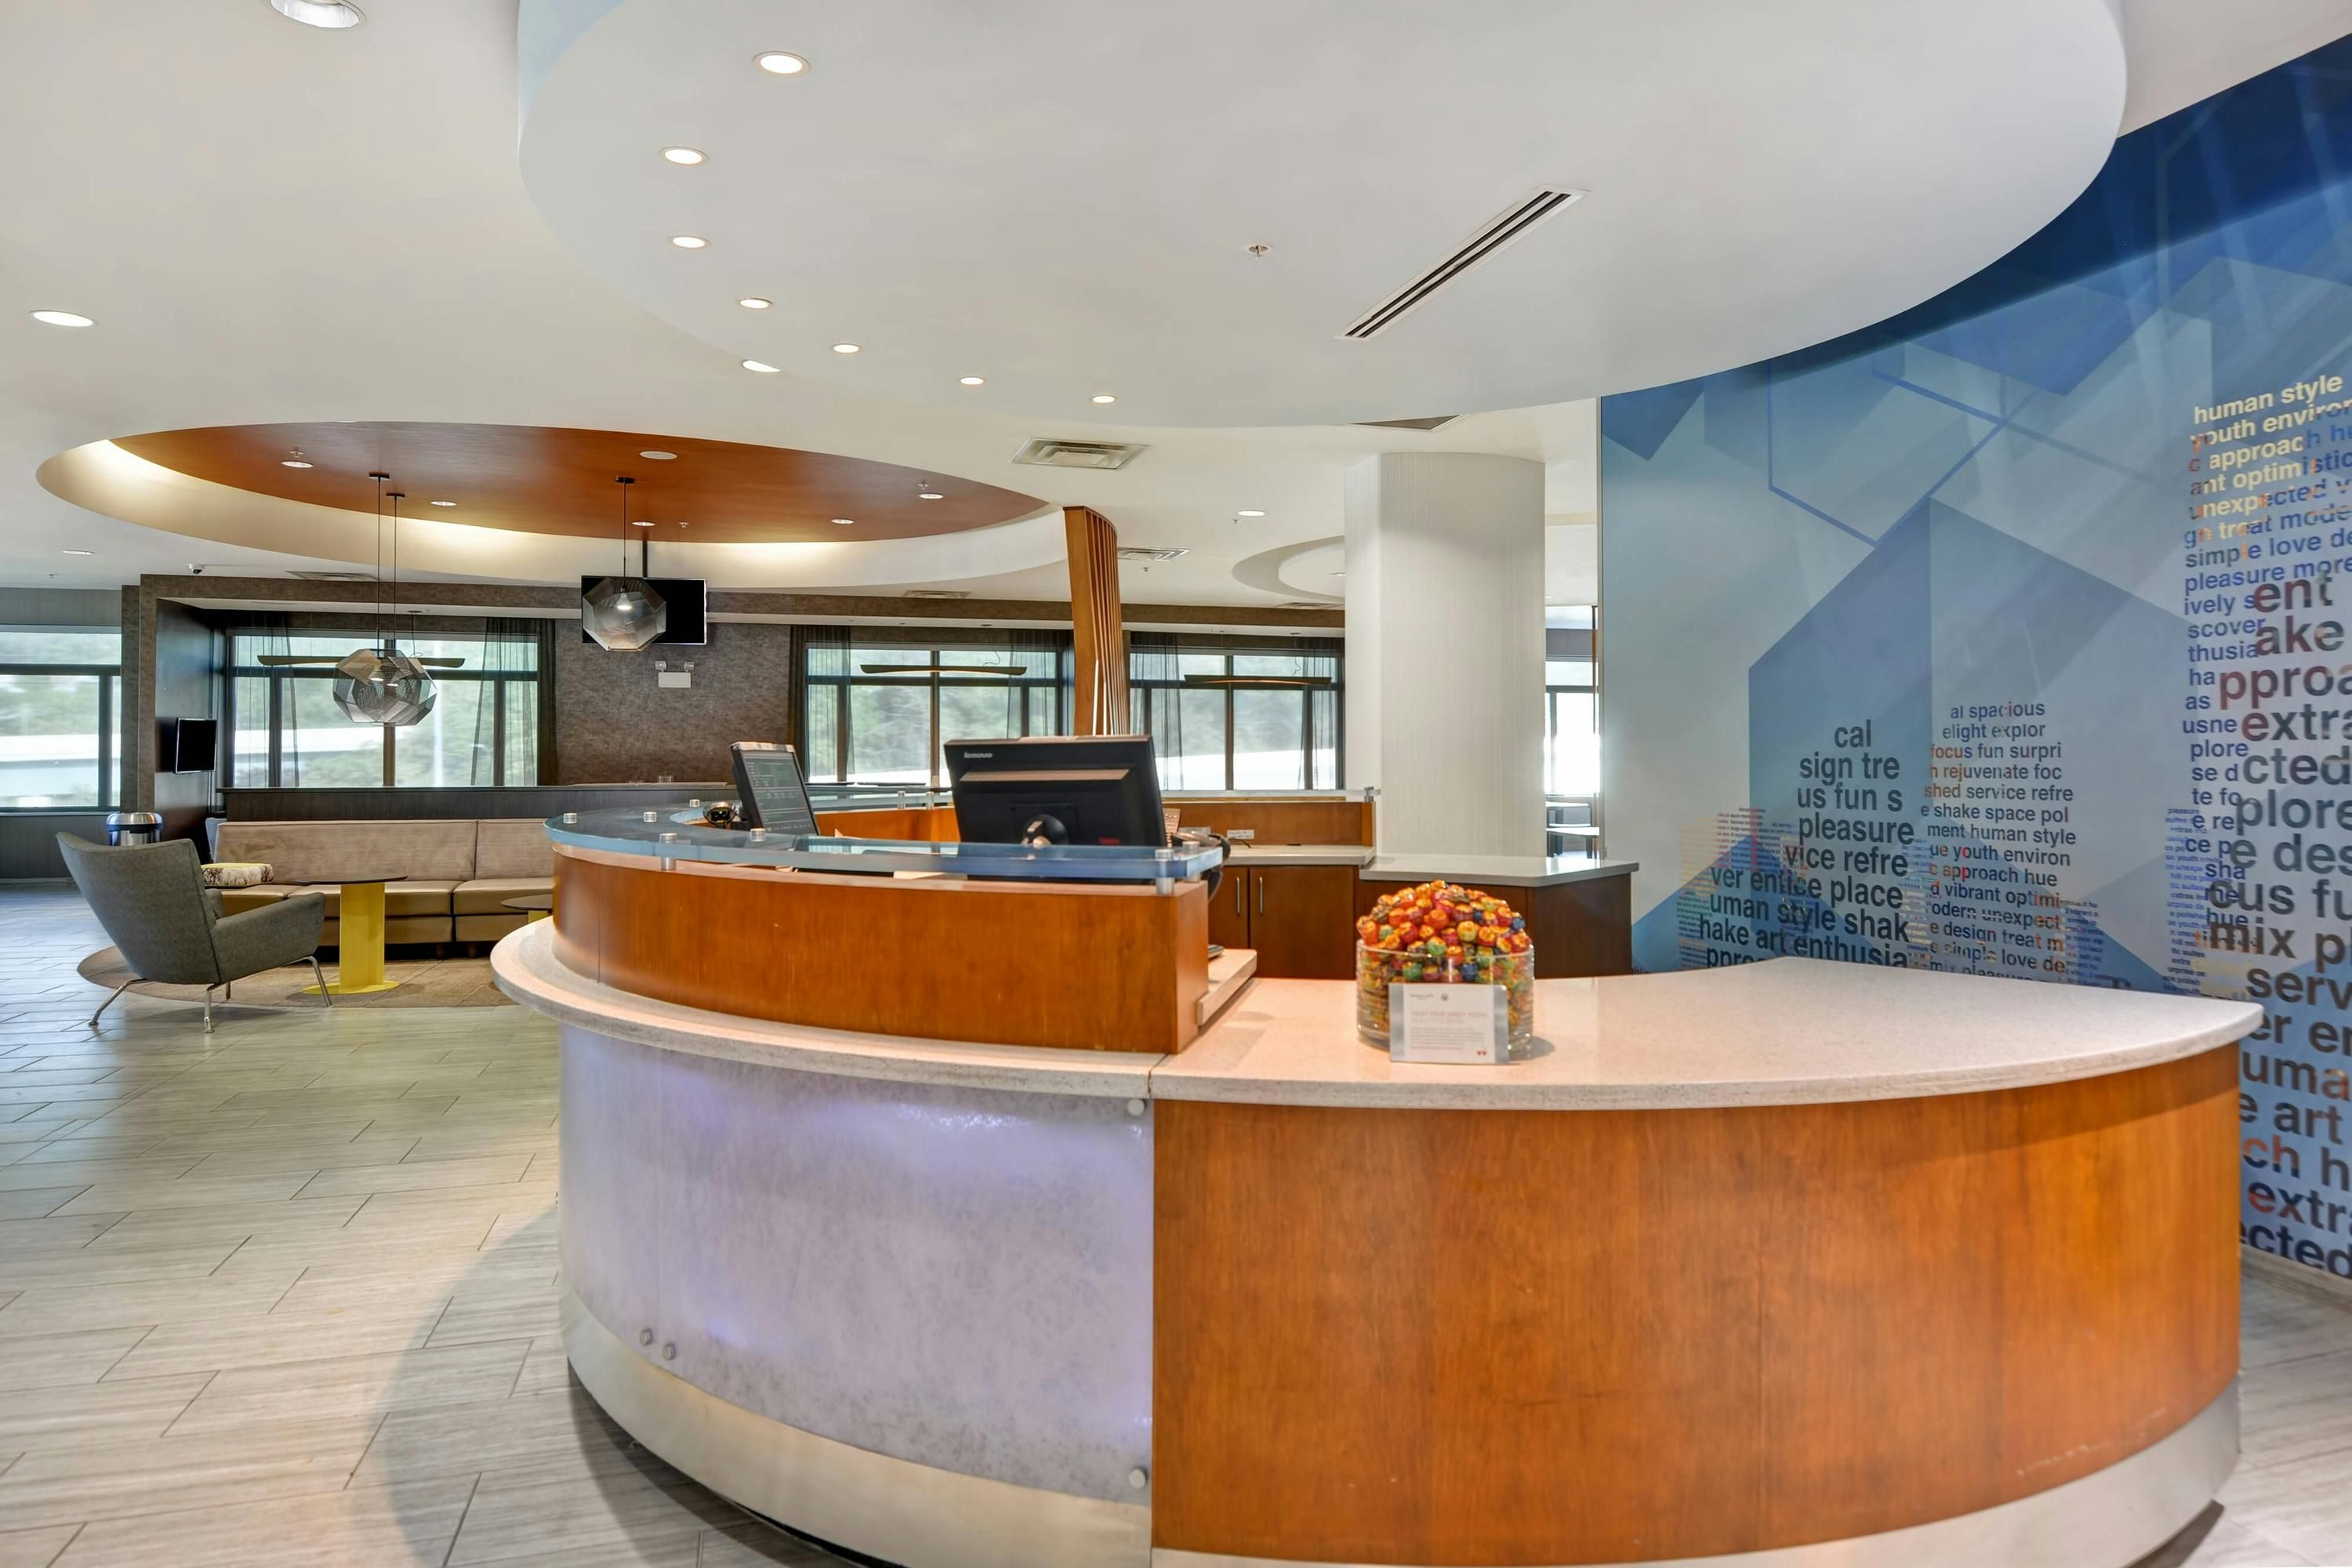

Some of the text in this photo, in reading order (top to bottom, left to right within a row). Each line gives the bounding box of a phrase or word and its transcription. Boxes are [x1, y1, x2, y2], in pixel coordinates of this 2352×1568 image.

[2194, 375, 2343, 424] human style
[2190, 419, 2256, 453] youth
[2190, 474, 2226, 495] ant
[2185, 542, 2261, 568] simple
[2269, 535, 2321, 557] love
[2185, 565, 2285, 596] pleasure
[2253, 573, 2333, 613] ent
[2184, 594, 2236, 616] ively
[2188, 618, 2266, 639] scover
[2255, 615, 2344, 655] ake
[2188, 641, 2259, 662] thusia
[2190, 669, 2215, 686] ha
[1969, 701, 2045, 721] spacious
[2186, 695, 2211, 710] as
[1834, 719, 1871, 748] cal
[1943, 723, 1987, 742] elight
[1930, 742, 2061, 762] focus fun surpri
[2190, 739, 2249, 761] plore
[1799, 751, 1900, 786] sign tre
[1944, 764, 2029, 782] rejuvenate
[2034, 764, 2062, 779] foc
[2192, 766, 2217, 781] se
[2243, 745, 2350, 785] cted
[1797, 782, 1903, 812] us fun s
[1924, 783, 2074, 801] shed service refre
[2192, 788, 2212, 805] te
[1921, 803, 2069, 826] e shake space pol
[2213, 816, 2234, 830] re
[1799, 811, 1915, 846] pleasure
[1928, 824, 2077, 848] ment human style
[1931, 844, 1948, 857] ue
[1953, 844, 1998, 862] youth
[2004, 848, 2071, 866] environ
[2186, 838, 2211, 853] ce
[2230, 840, 2256, 869] e
[1785, 844, 1835, 870] vice
[1844, 846, 1908, 877] refre
[2205, 861, 2246, 880] sha
[1711, 866, 1744, 889] ver
[1751, 869, 1823, 898] entice
[1831, 875, 1904, 909] place
[1943, 865, 2018, 883] approach
[2024, 869, 2058, 887] hue
[1944, 882, 2001, 902] vibrant
[2005, 891, 2061, 909] optimi
[1711, 894, 1769, 920] uman
[1844, 908, 1911, 942] shak
[1700, 913, 1749, 946] hake
[1756, 927, 1787, 953] art
[1944, 921, 1997, 944] design
[2002, 929, 2042, 949] treat
[2209, 916, 2296, 960] mix
[2002, 949, 2038, 969] love
[2246, 968, 2352, 1011] serv
[2242, 1051, 2351, 1102] uma
[2274, 1102, 2343, 1145] art
[2243, 1134, 2300, 1178] ch
